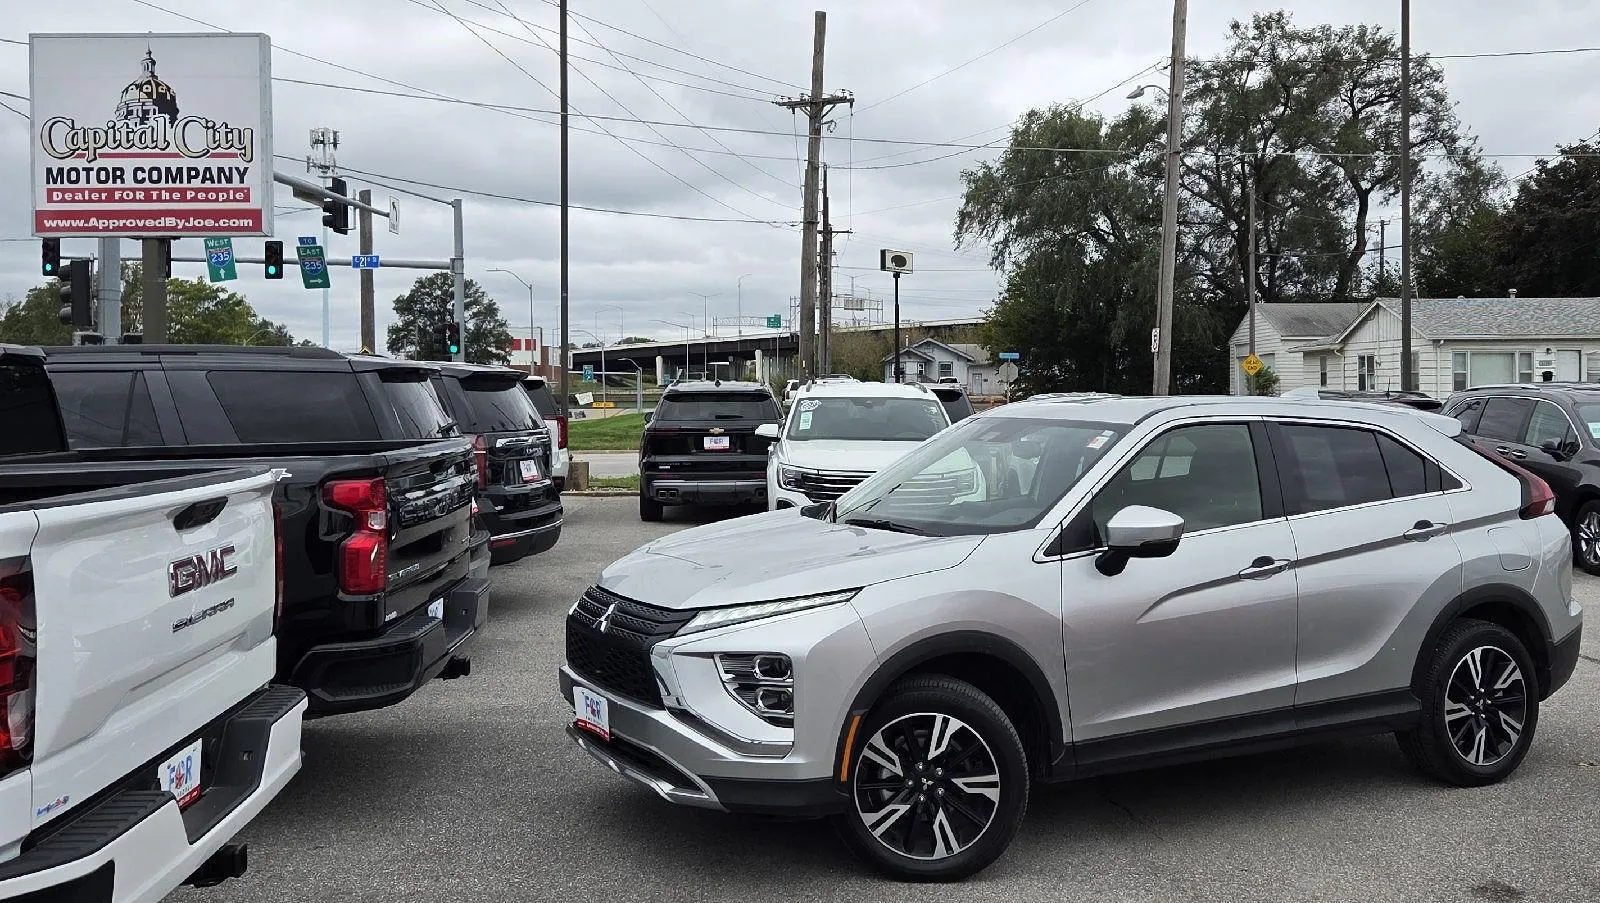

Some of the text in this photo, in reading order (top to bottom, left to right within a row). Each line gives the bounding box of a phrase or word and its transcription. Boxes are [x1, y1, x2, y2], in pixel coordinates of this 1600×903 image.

[41, 114, 253, 163] Capital City
[45, 166, 249, 184] MOTOR COMPANY
[52, 190, 245, 202] Dealer FOR The People
[44, 217, 253, 229] www.ApprovedByJoe.com
[206, 239, 229, 247] WEST
[211, 251, 230, 262] 235
[300, 248, 321, 256] EAST
[304, 261, 323, 270] 235
[168, 545, 237, 598] GMC
